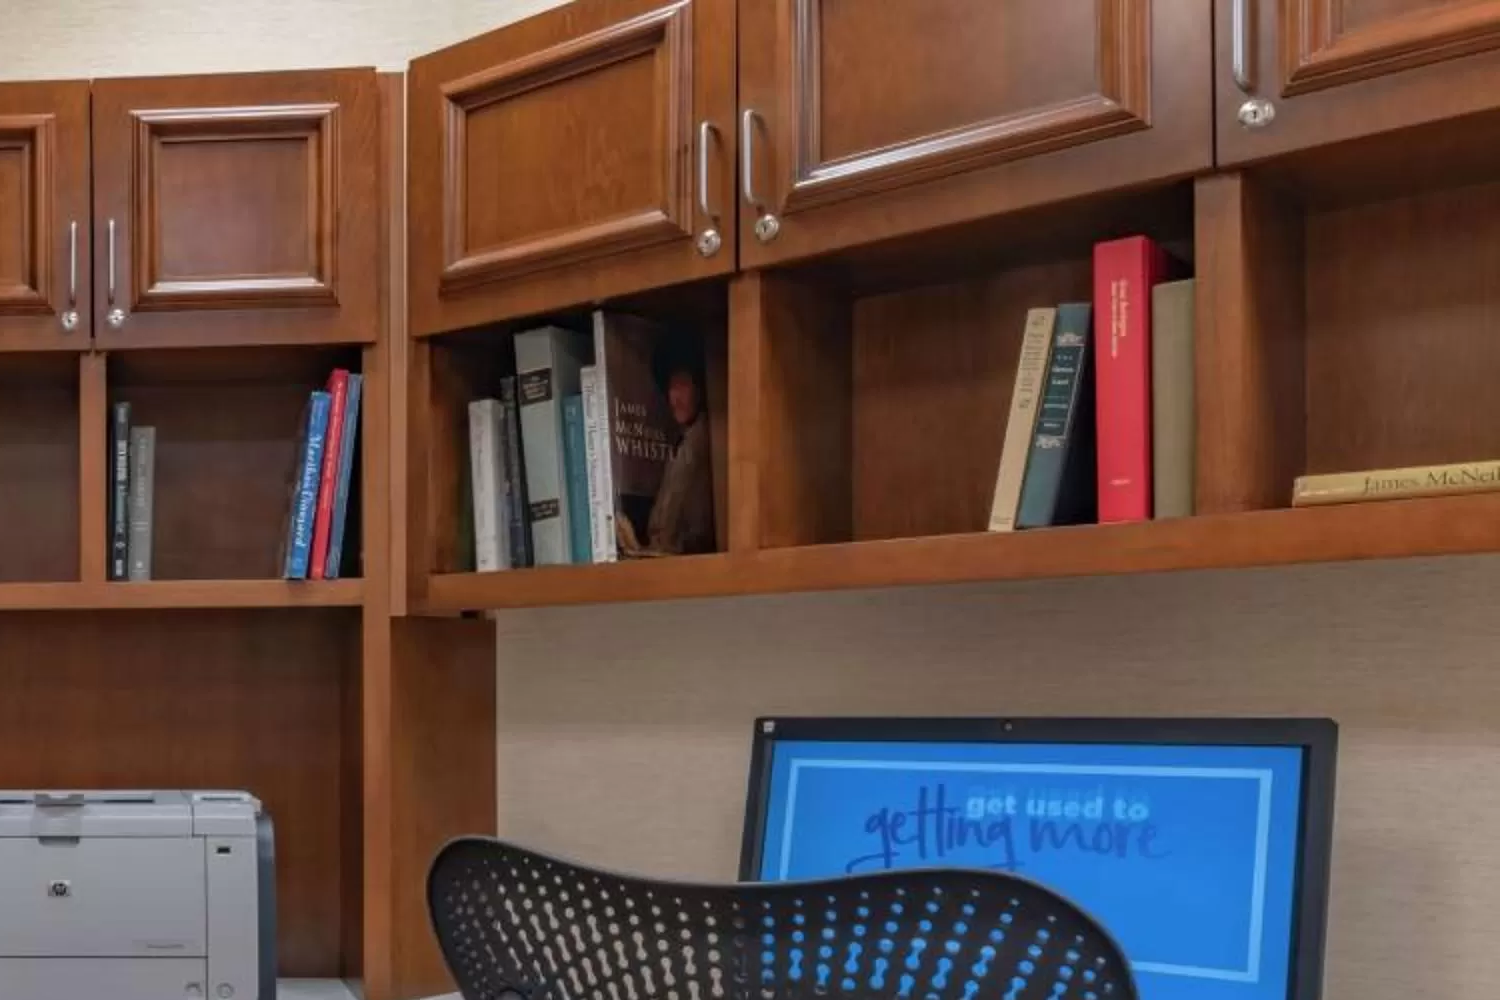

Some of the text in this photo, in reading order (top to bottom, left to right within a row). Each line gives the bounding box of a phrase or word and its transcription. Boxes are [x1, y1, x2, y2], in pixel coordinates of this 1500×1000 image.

[845, 783, 1173, 872] getting more
[966, 794, 1150, 821] get used to
